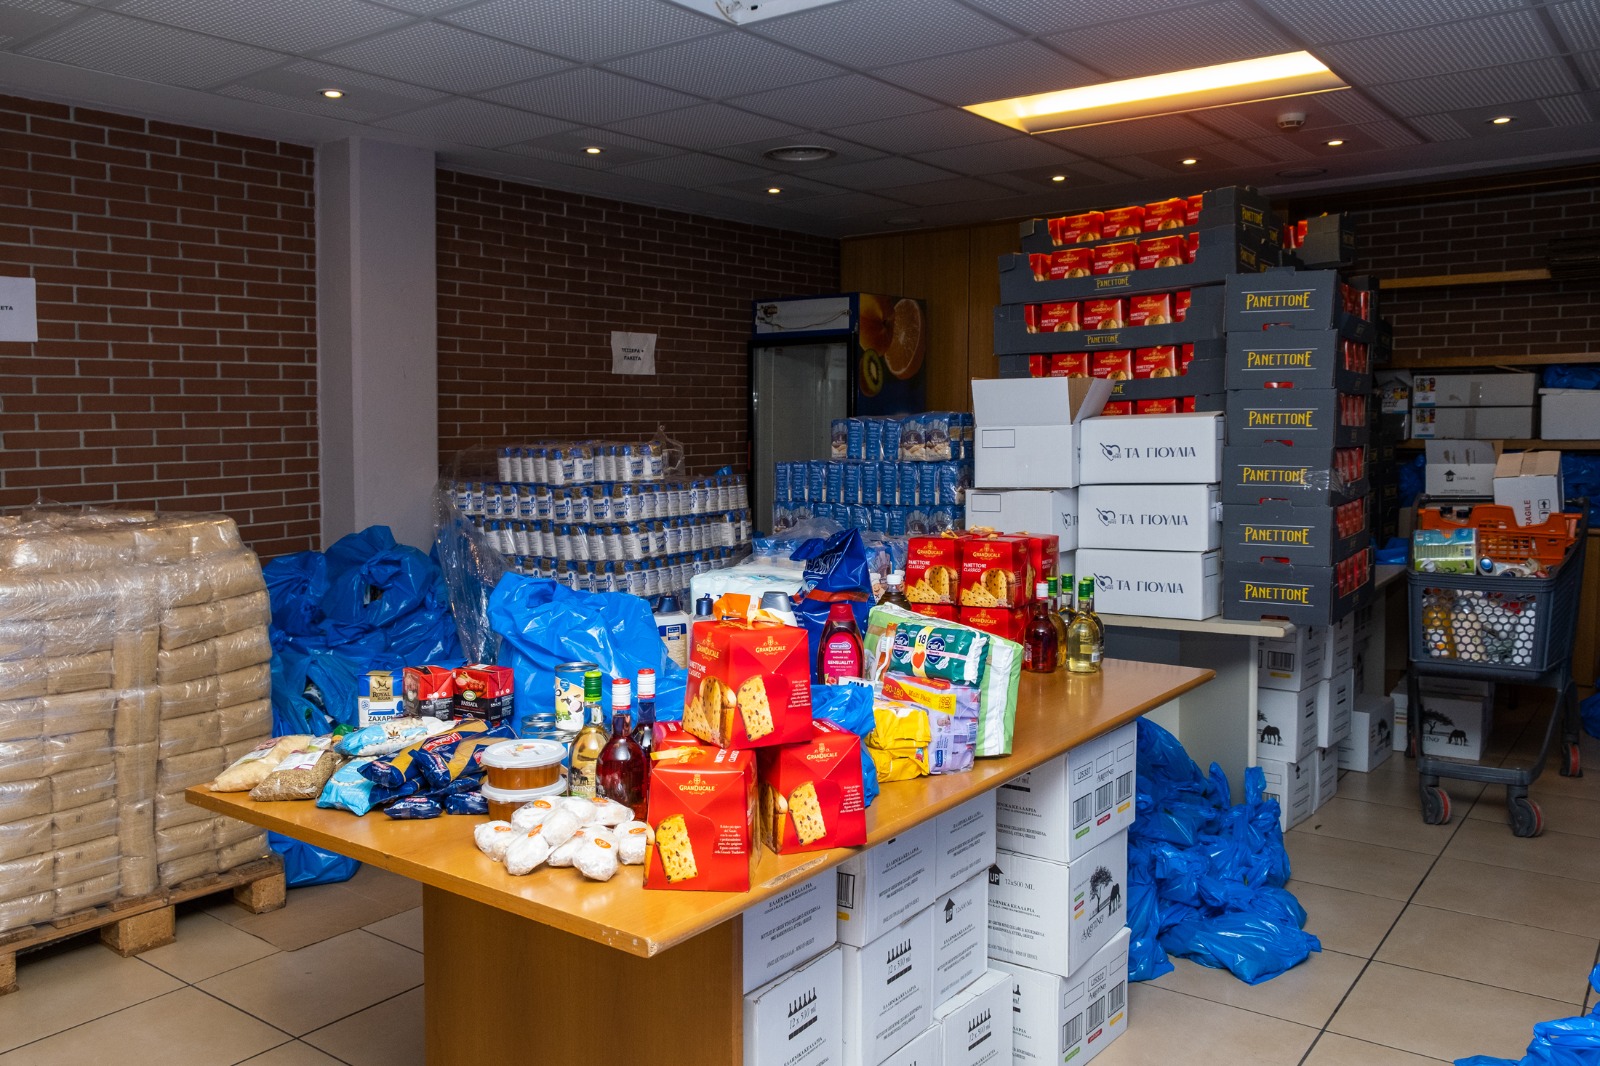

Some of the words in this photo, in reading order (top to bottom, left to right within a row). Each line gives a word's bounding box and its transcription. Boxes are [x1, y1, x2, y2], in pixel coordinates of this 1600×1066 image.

[1246, 292, 1311, 310] PANETTONE
[1247, 351, 1312, 368] PANETTONE
[1249, 411, 1313, 427] PANETTONE
[1125, 448, 1140, 458] ΤΑ
[1147, 446, 1196, 458] ΓΙΟΥΛΙΑ
[1243, 468, 1308, 485] PANETTONE
[1120, 514, 1134, 525] ΤΑ
[1141, 515, 1188, 526] ΓΙΟΥΛΙΑ
[1245, 527, 1309, 544] PANETTONE
[1116, 580, 1131, 591] ΤΑ
[1137, 581, 1184, 594] ΓΙΟΥΛΙΑ
[1245, 584, 1309, 604] PANETTONE
[918, 634, 926, 644] 18
[990, 874, 999, 882] UP
[789, 1016, 796, 1029] 12
